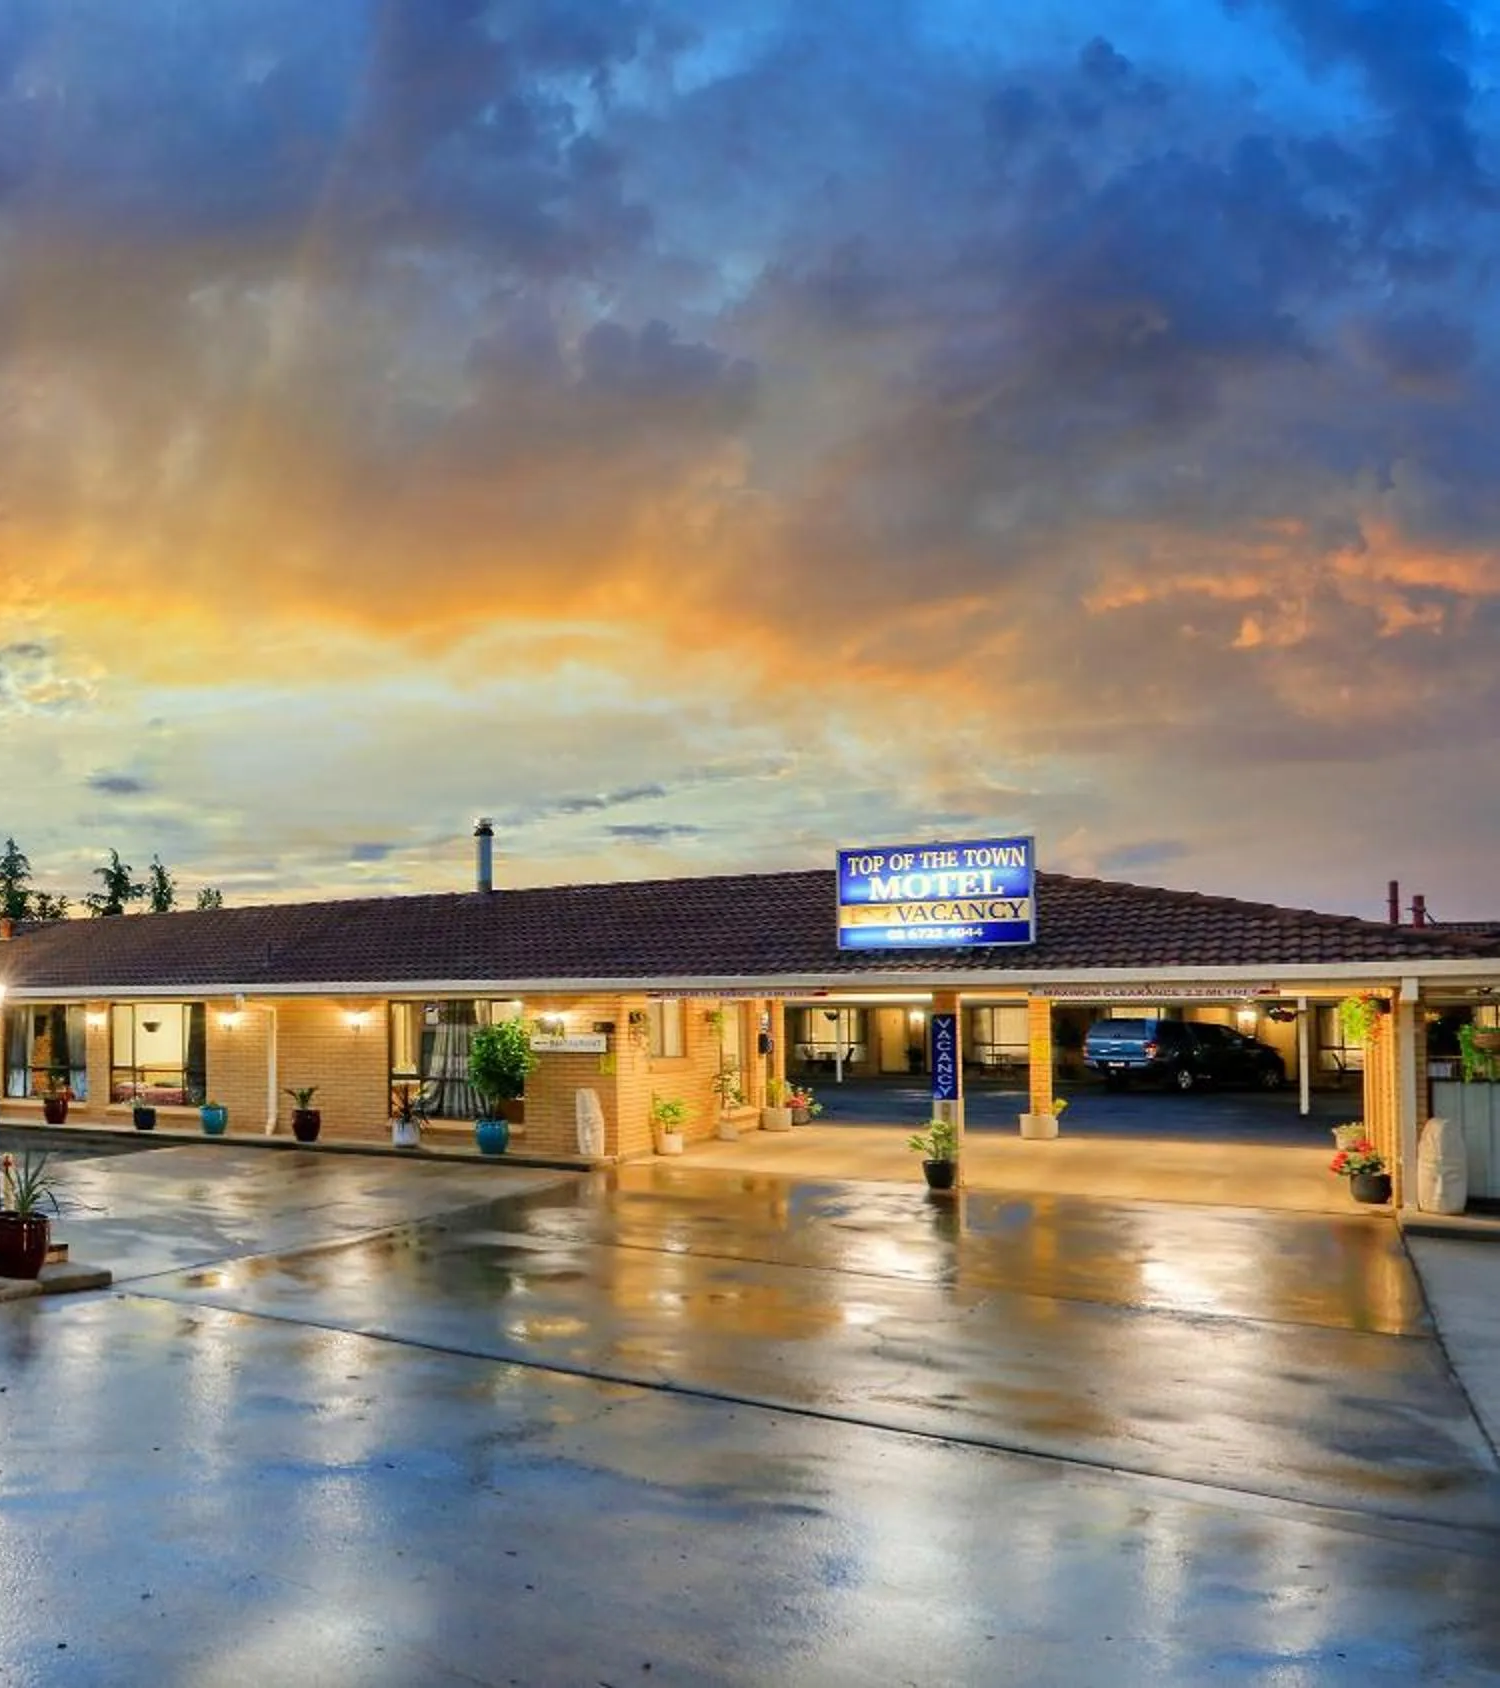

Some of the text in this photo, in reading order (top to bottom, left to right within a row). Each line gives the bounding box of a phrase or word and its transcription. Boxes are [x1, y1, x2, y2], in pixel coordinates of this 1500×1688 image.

[847, 846, 1026, 877] TOP OF THE TOWN
[867, 869, 1004, 901] MOTEL
[895, 900, 1026, 924] VACANCY
[1043, 988, 1101, 997] MAXIMUM
[1103, 988, 1182, 997] CLEARANCE
[936, 1017, 953, 1097] VACANCY
